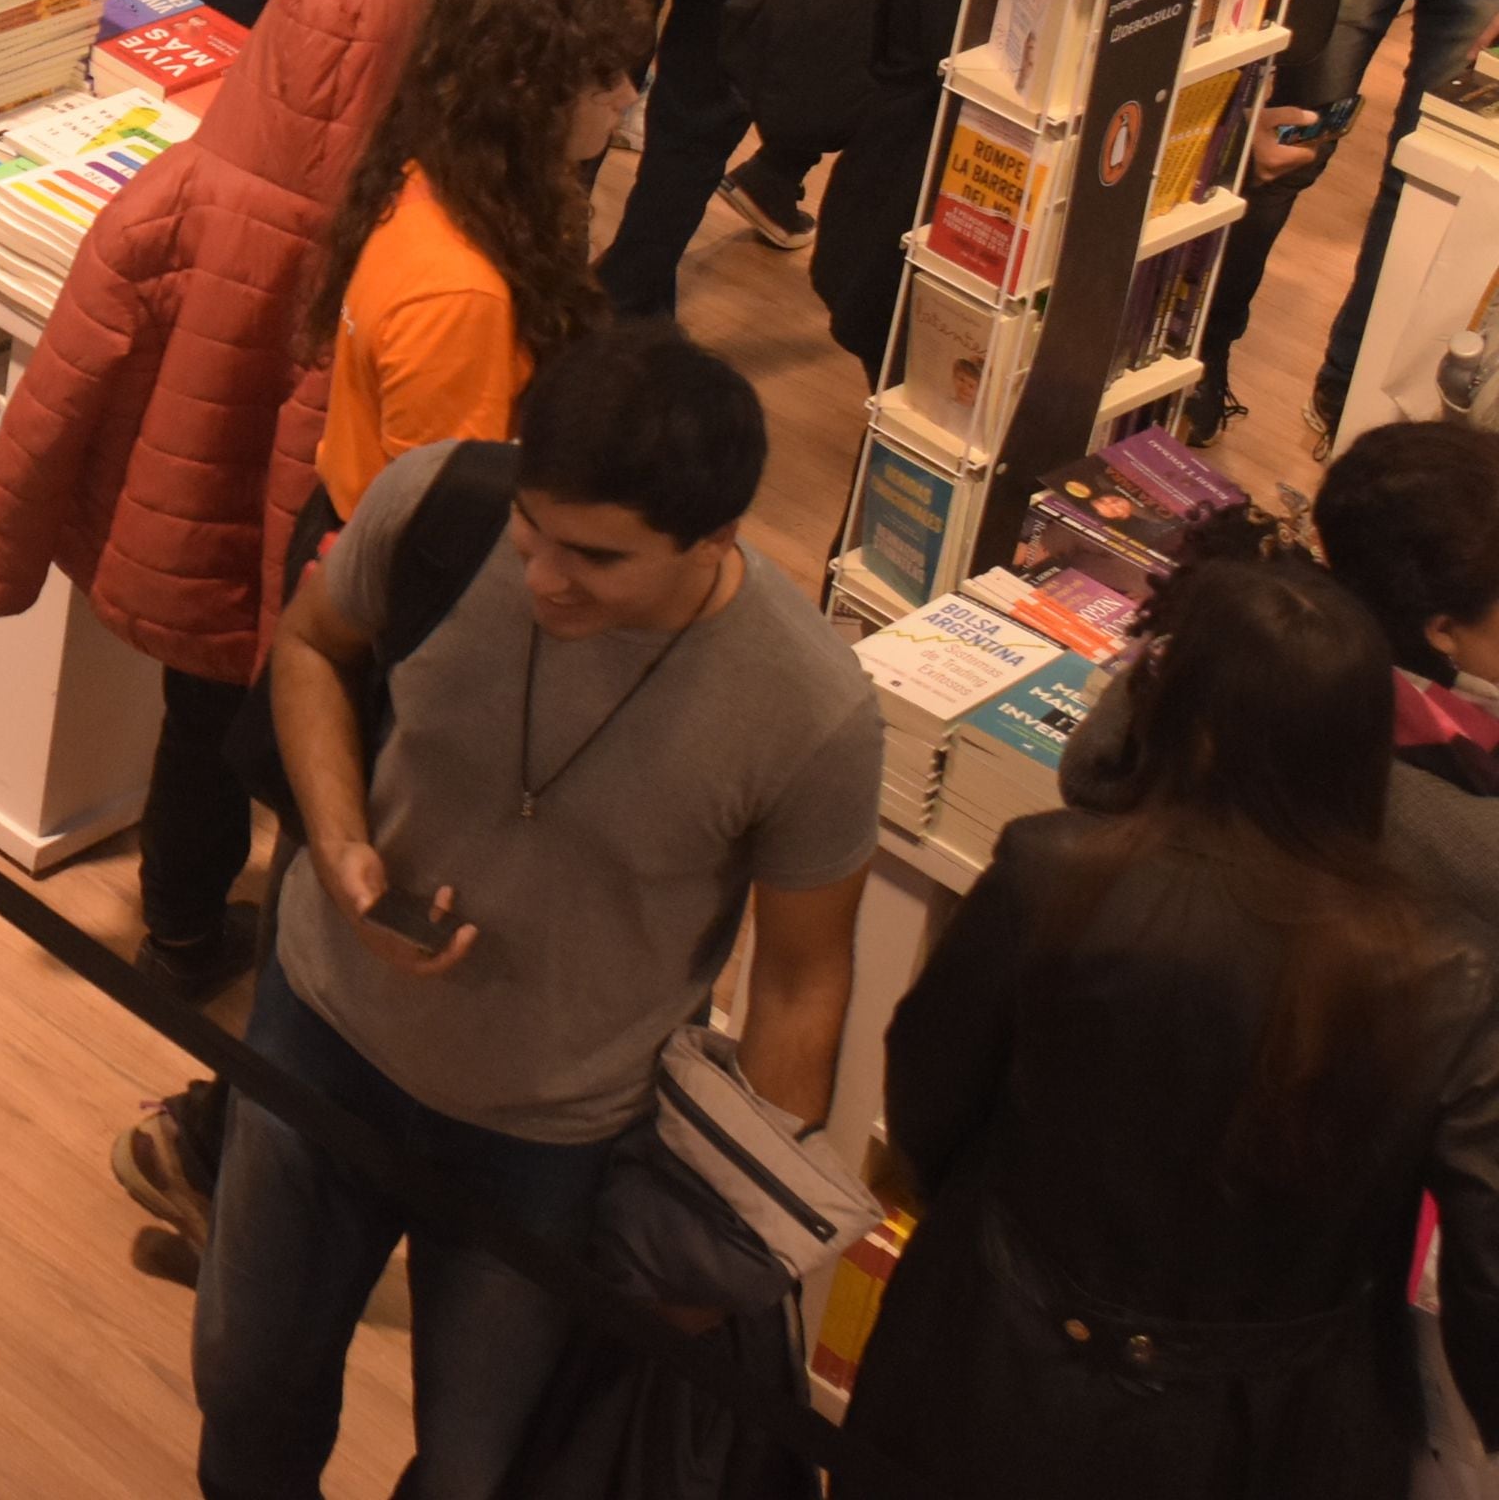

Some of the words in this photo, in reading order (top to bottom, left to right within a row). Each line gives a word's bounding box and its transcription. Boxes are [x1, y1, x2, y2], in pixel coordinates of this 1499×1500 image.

[1120, 2, 1183, 39] DEBOLSILLO
[117, 31, 192, 80] VIVE
[141, 22, 216, 71] MÁS
[951, 152, 969, 177] LA
[972, 139, 1025, 181] ROMPE
[938, 601, 1003, 636] BOLSA
[921, 611, 1026, 669] ARGENTINA
[916, 663, 973, 697] Exitosos
[920, 648, 942, 664] de
[940, 655, 989, 690] Trading
[943, 643, 1005, 680] Sistemas
